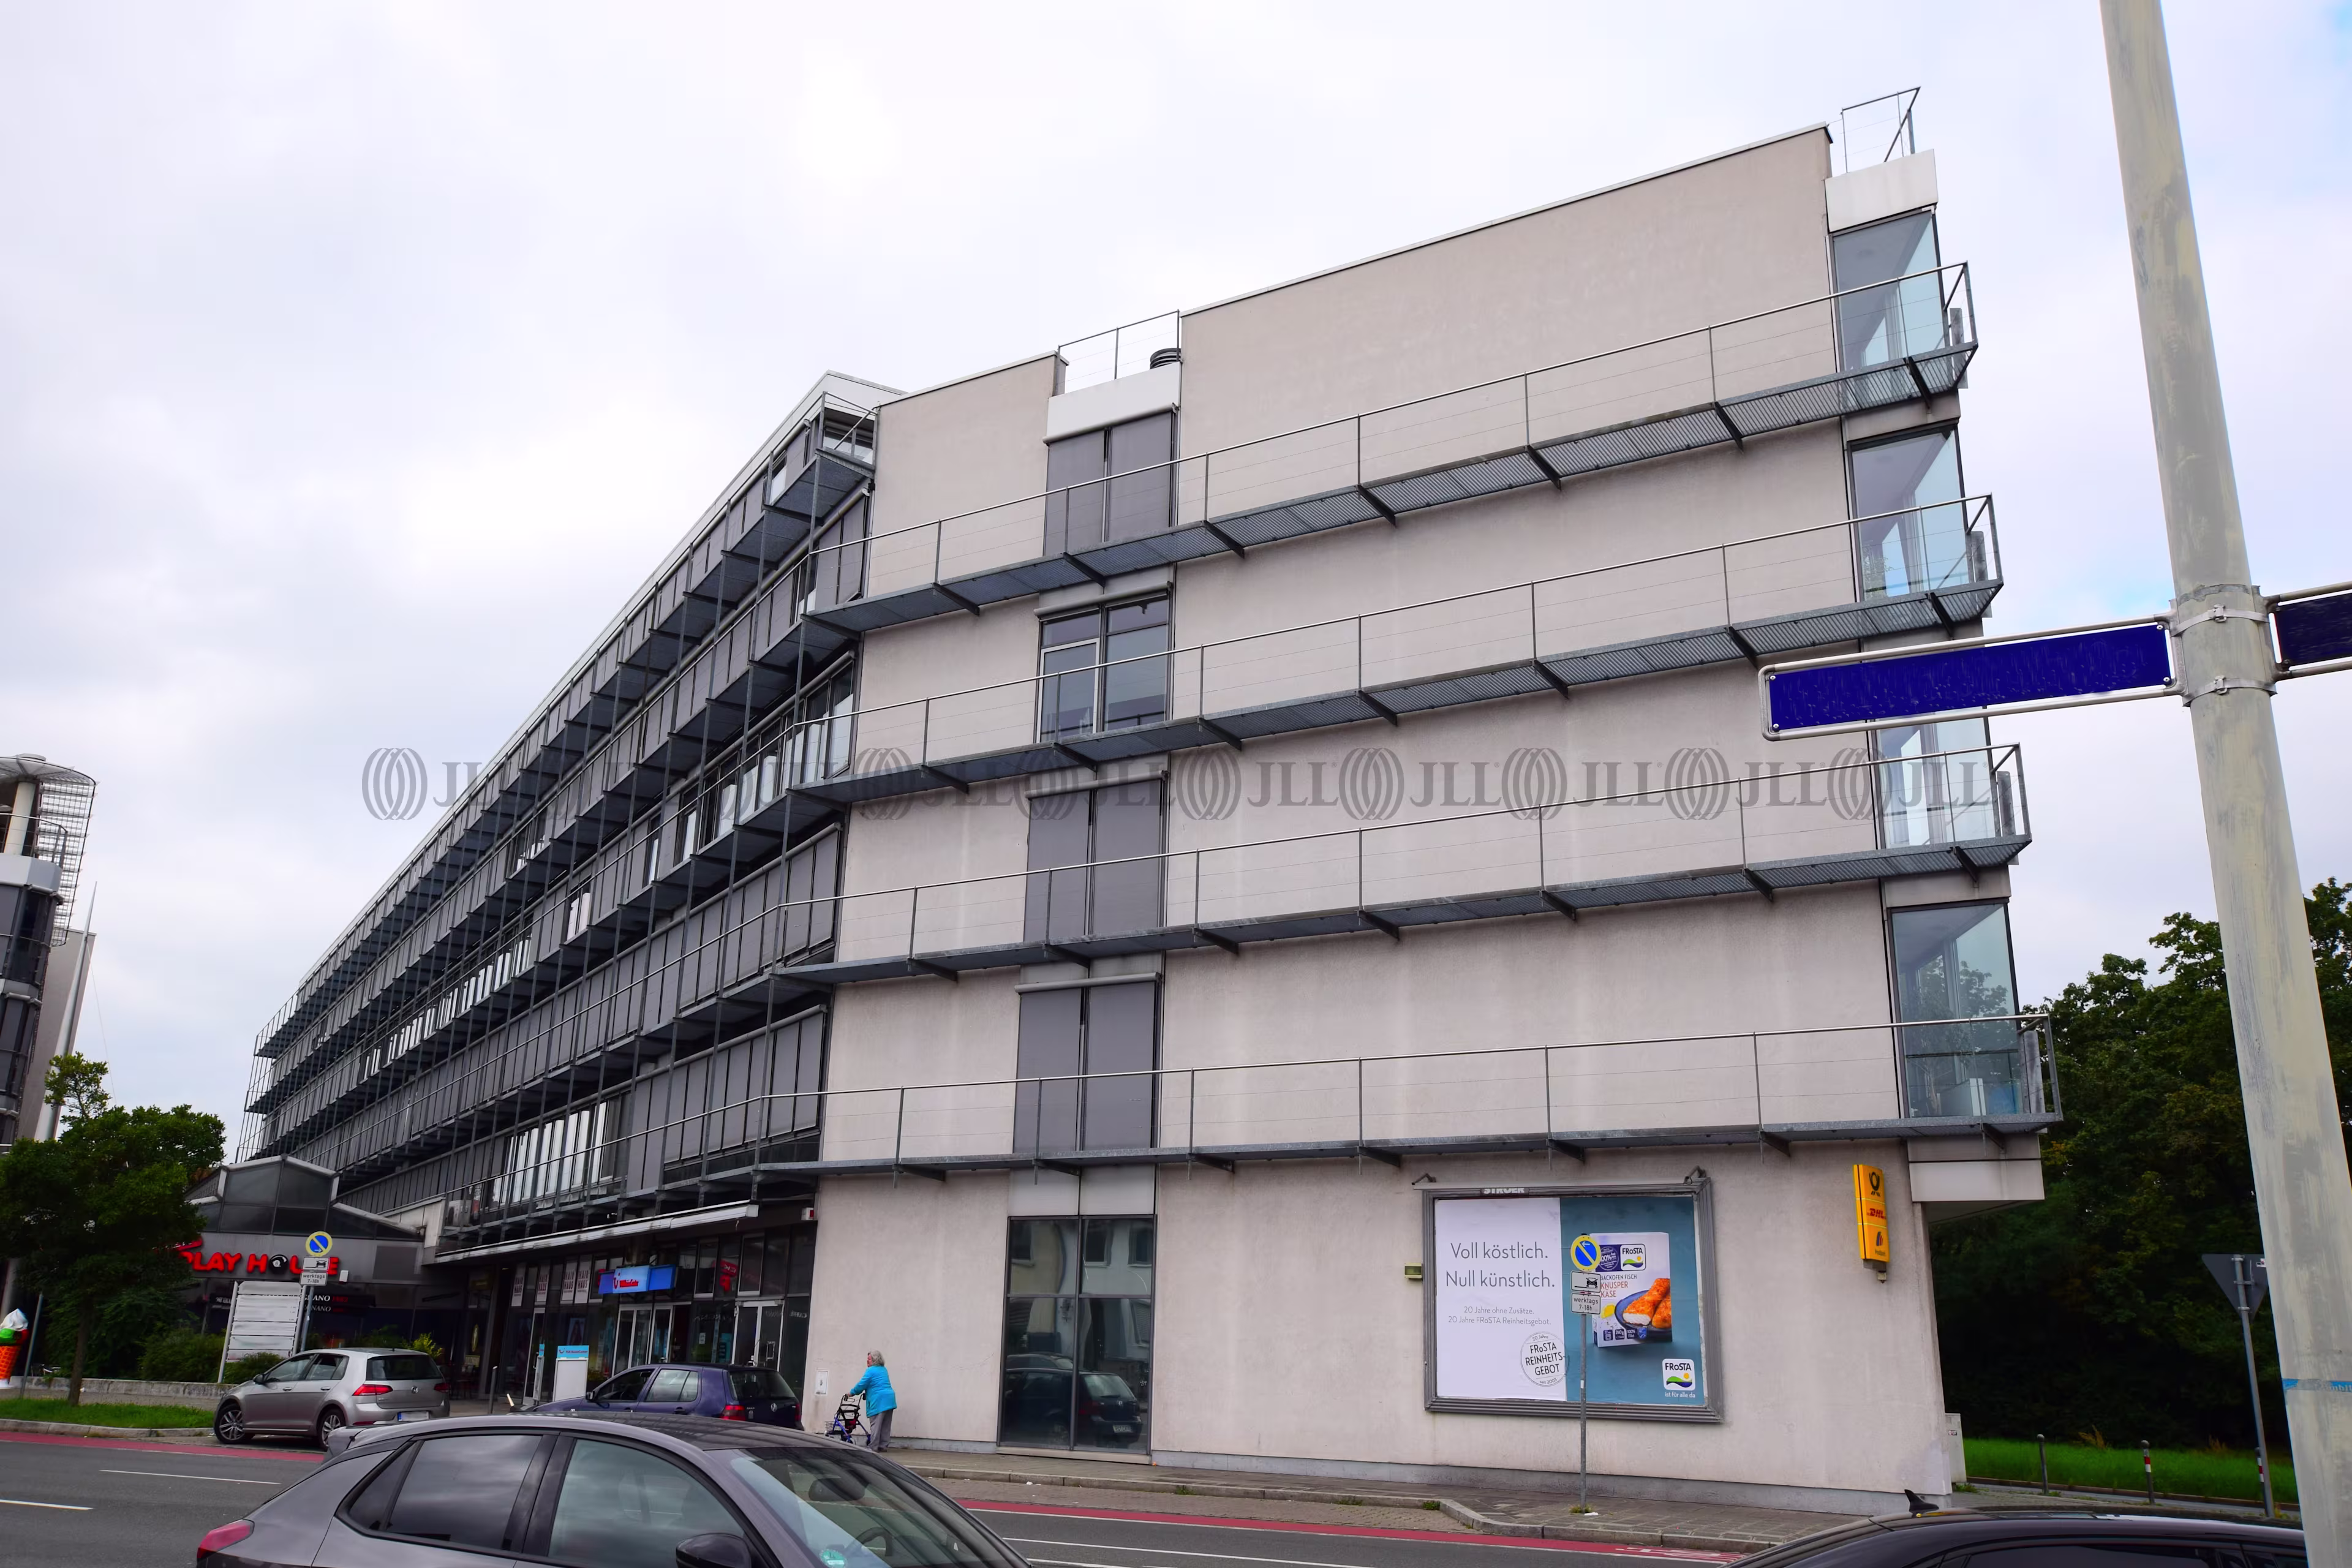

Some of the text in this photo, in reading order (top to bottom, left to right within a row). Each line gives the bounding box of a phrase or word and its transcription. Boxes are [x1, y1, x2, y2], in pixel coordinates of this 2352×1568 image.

[1869, 1208, 1885, 1219] DHL
[1450, 1241, 1548, 1259] Voll köstlich.
[1446, 1270, 1555, 1287] Null künstlich.
[1600, 1281, 1628, 1290] KNUSPER
[1502, 1317, 1551, 1327] Reinheitsgebot.
[1529, 1341, 1557, 1354] FRoSTA
[1525, 1351, 1566, 1366] REINHEITS-
[1534, 1363, 1559, 1376] GEBOT
